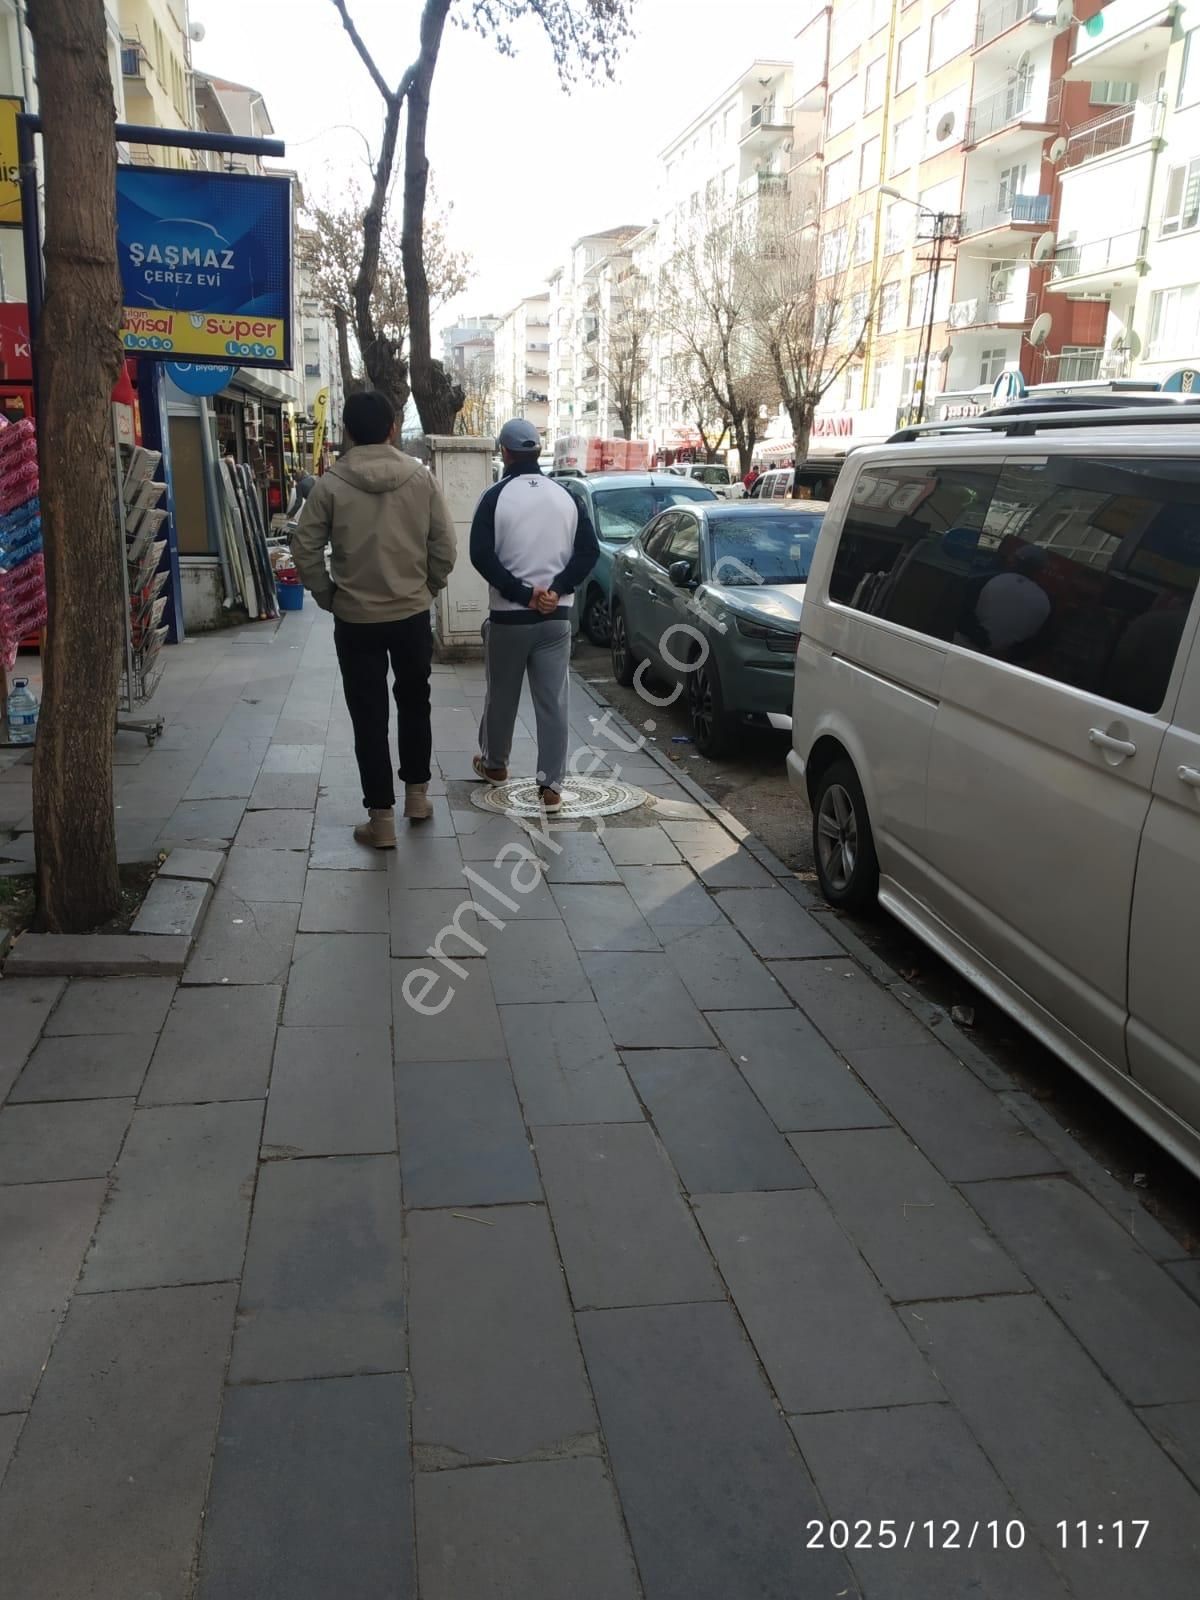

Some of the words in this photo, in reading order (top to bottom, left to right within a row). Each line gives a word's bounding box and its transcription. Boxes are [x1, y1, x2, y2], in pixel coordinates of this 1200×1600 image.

[129, 242, 235, 270] ŞAŞMAZ
[144, 270, 193, 286] ÇEREZ
[197, 270, 221, 287] EVİ
[206, 317, 277, 341] süper
